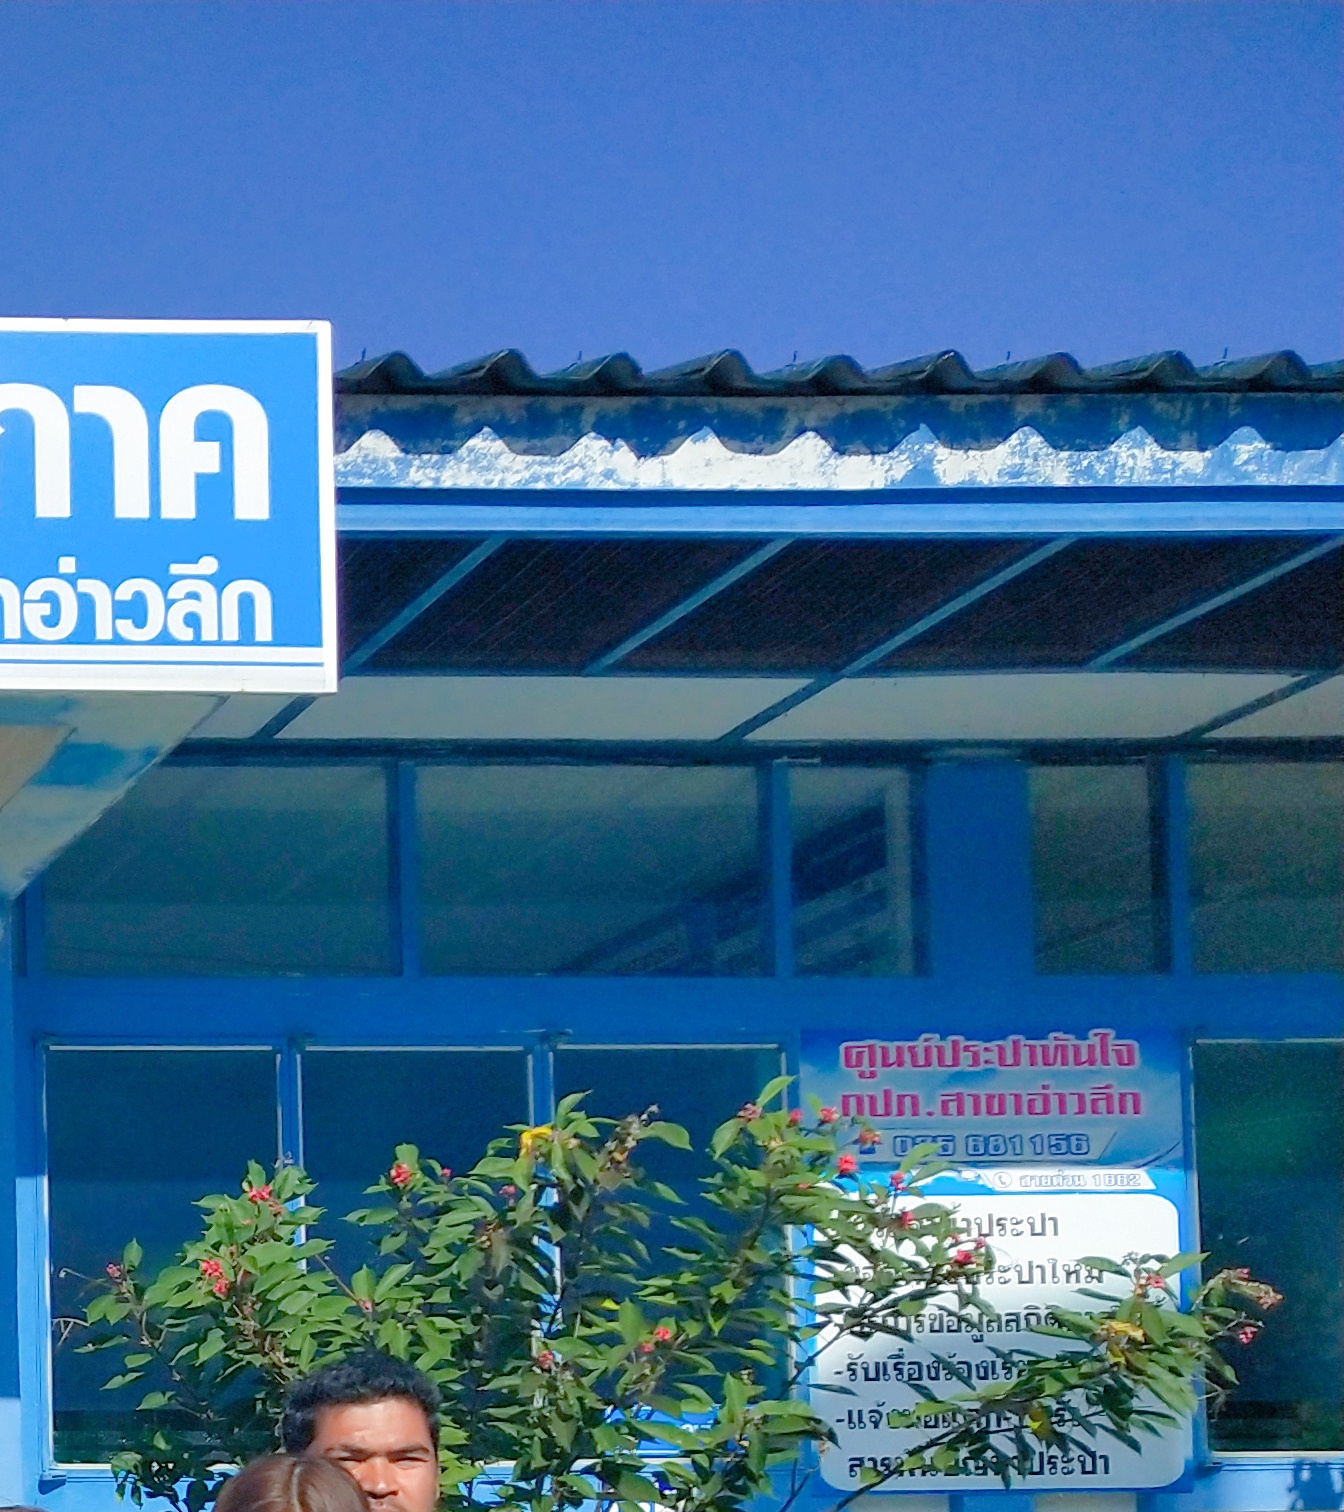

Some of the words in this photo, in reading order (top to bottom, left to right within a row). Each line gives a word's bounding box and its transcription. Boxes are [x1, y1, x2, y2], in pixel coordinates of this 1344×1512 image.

[841, 1030, 1137, 1079] ศูนย์ประปาทันใจ
[839, 1084, 1143, 1118] กปภ.สาขาอ่าวลึก
[965, 1132, 1091, 1157] 681156
